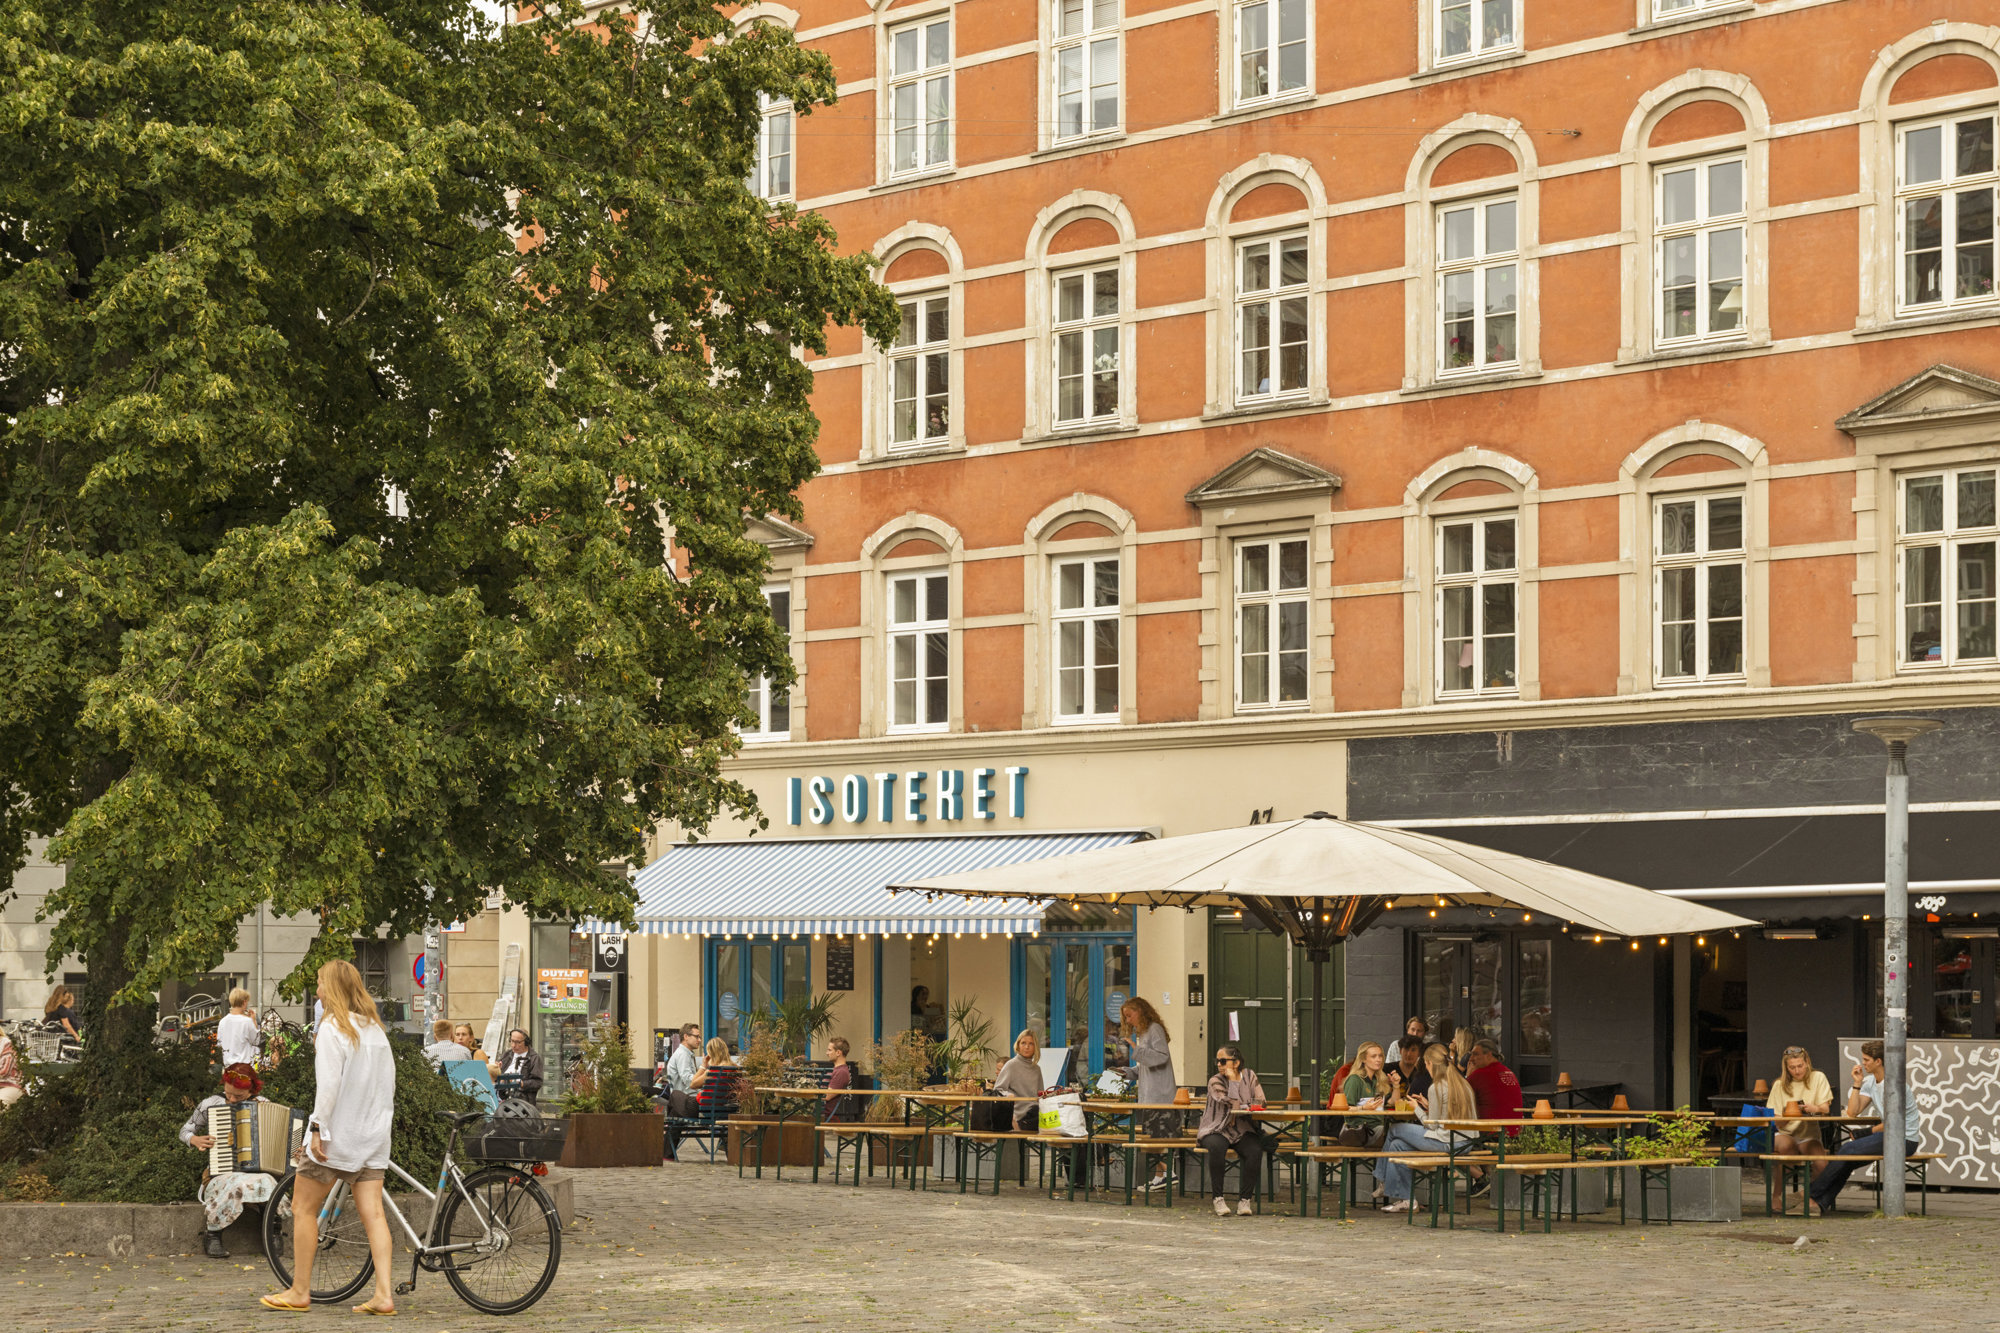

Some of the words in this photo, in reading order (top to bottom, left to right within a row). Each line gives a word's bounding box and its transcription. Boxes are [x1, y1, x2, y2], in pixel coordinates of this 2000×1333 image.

[786, 766, 1029, 826] ISOTEKET
[601, 936, 621, 945] CASH
[541, 969, 585, 978] OUTLET
